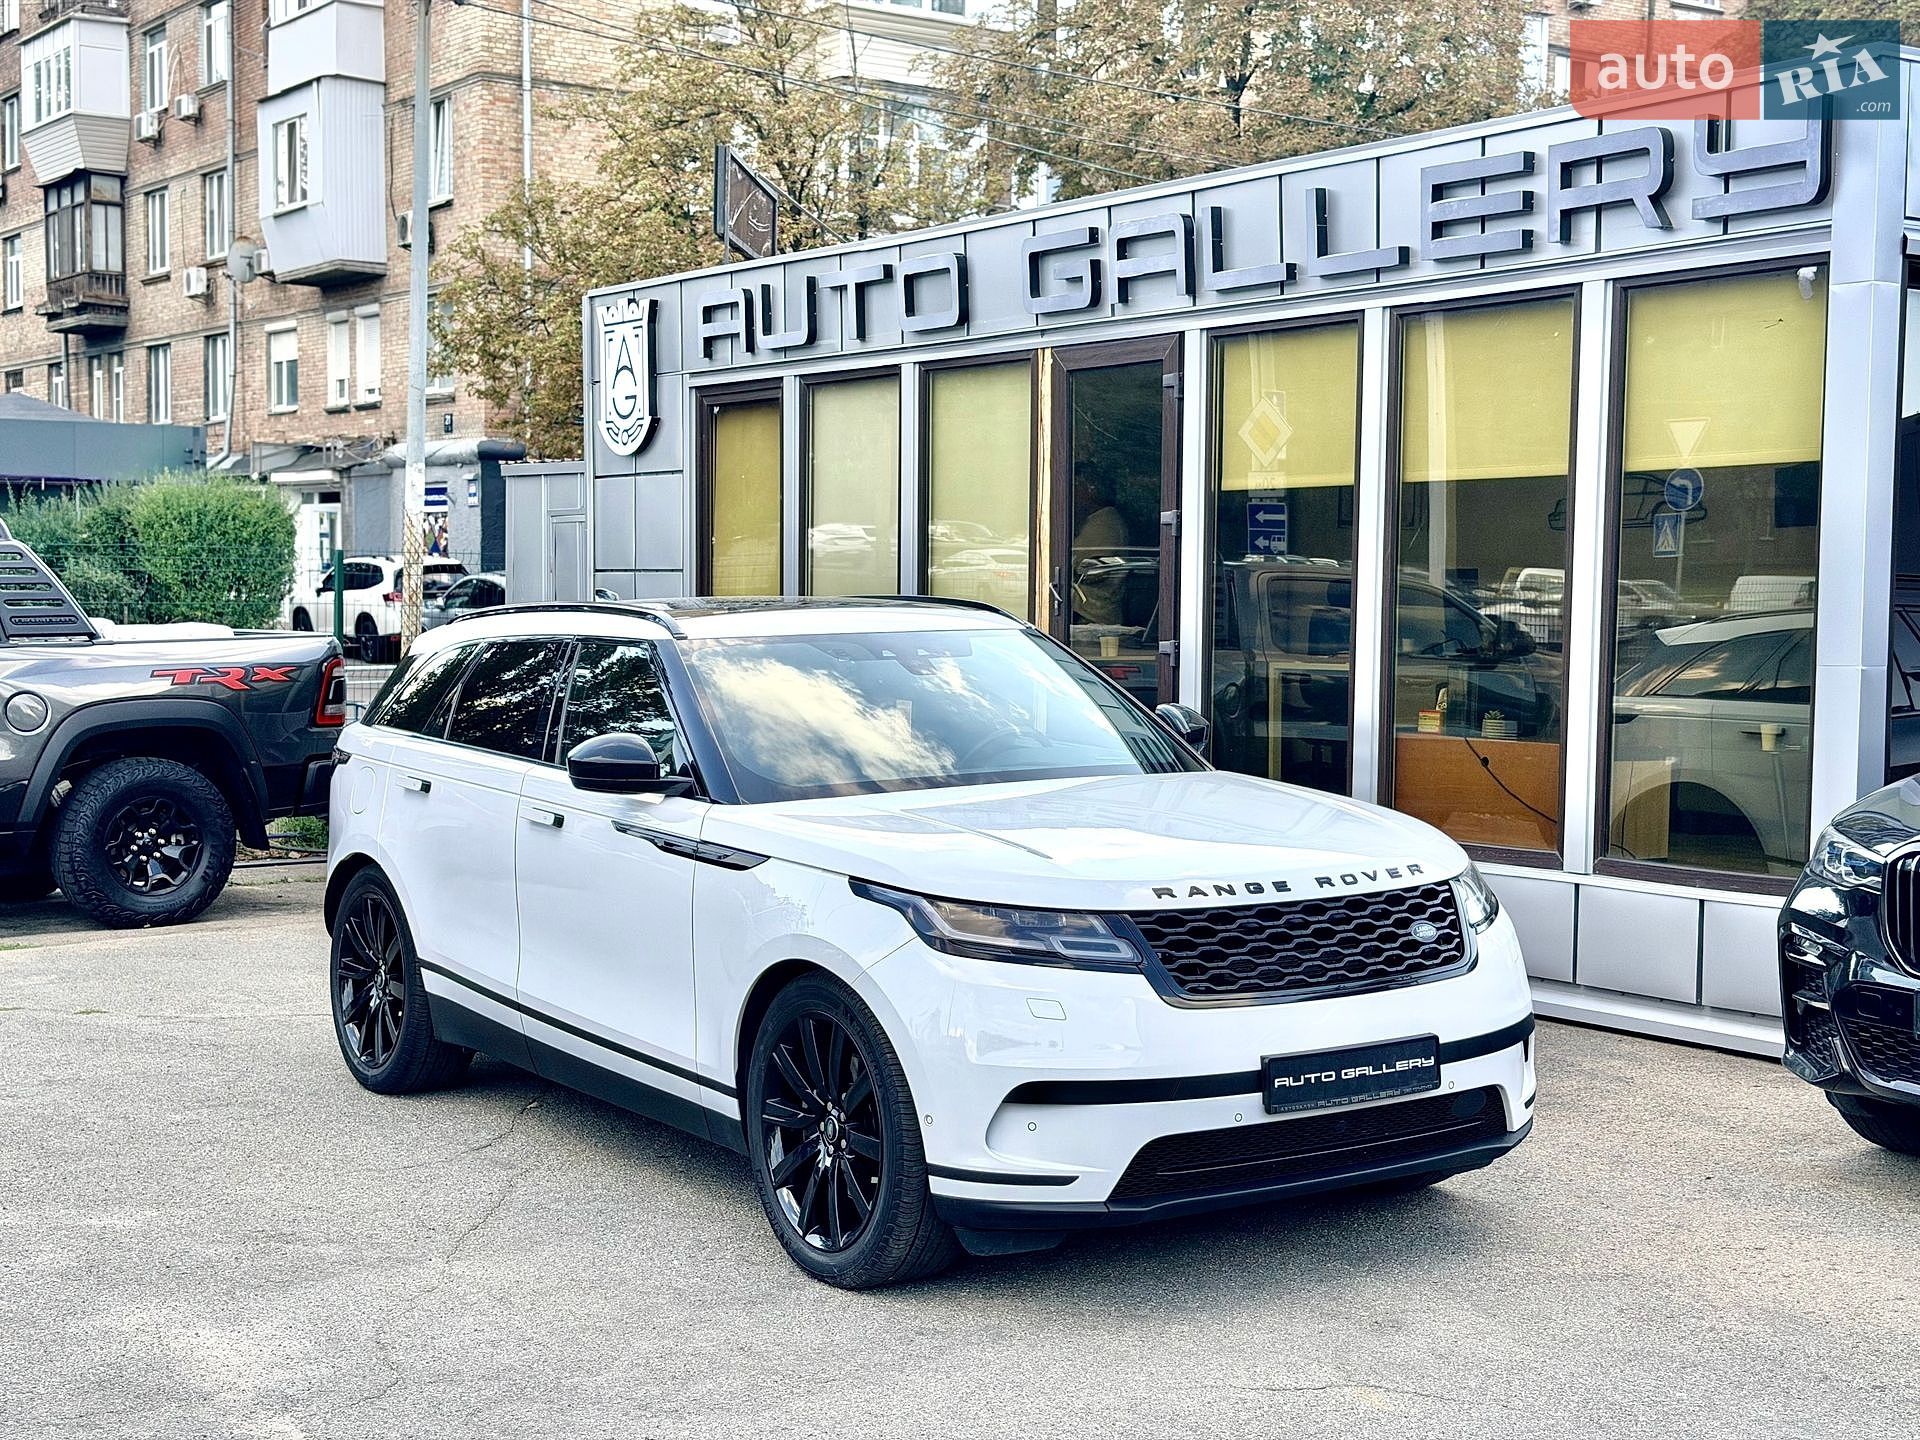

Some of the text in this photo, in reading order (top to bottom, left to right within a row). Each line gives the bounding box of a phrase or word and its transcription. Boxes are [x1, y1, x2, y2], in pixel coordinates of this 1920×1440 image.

[699, 94, 1834, 359] AUTO GALLERY
[151, 666, 299, 691] TRX
[1152, 863, 1425, 899] RANGE ROVER
[1274, 1055, 1435, 1089] AUTO GALLERY
[1317, 1097, 1349, 1108] AUTO
